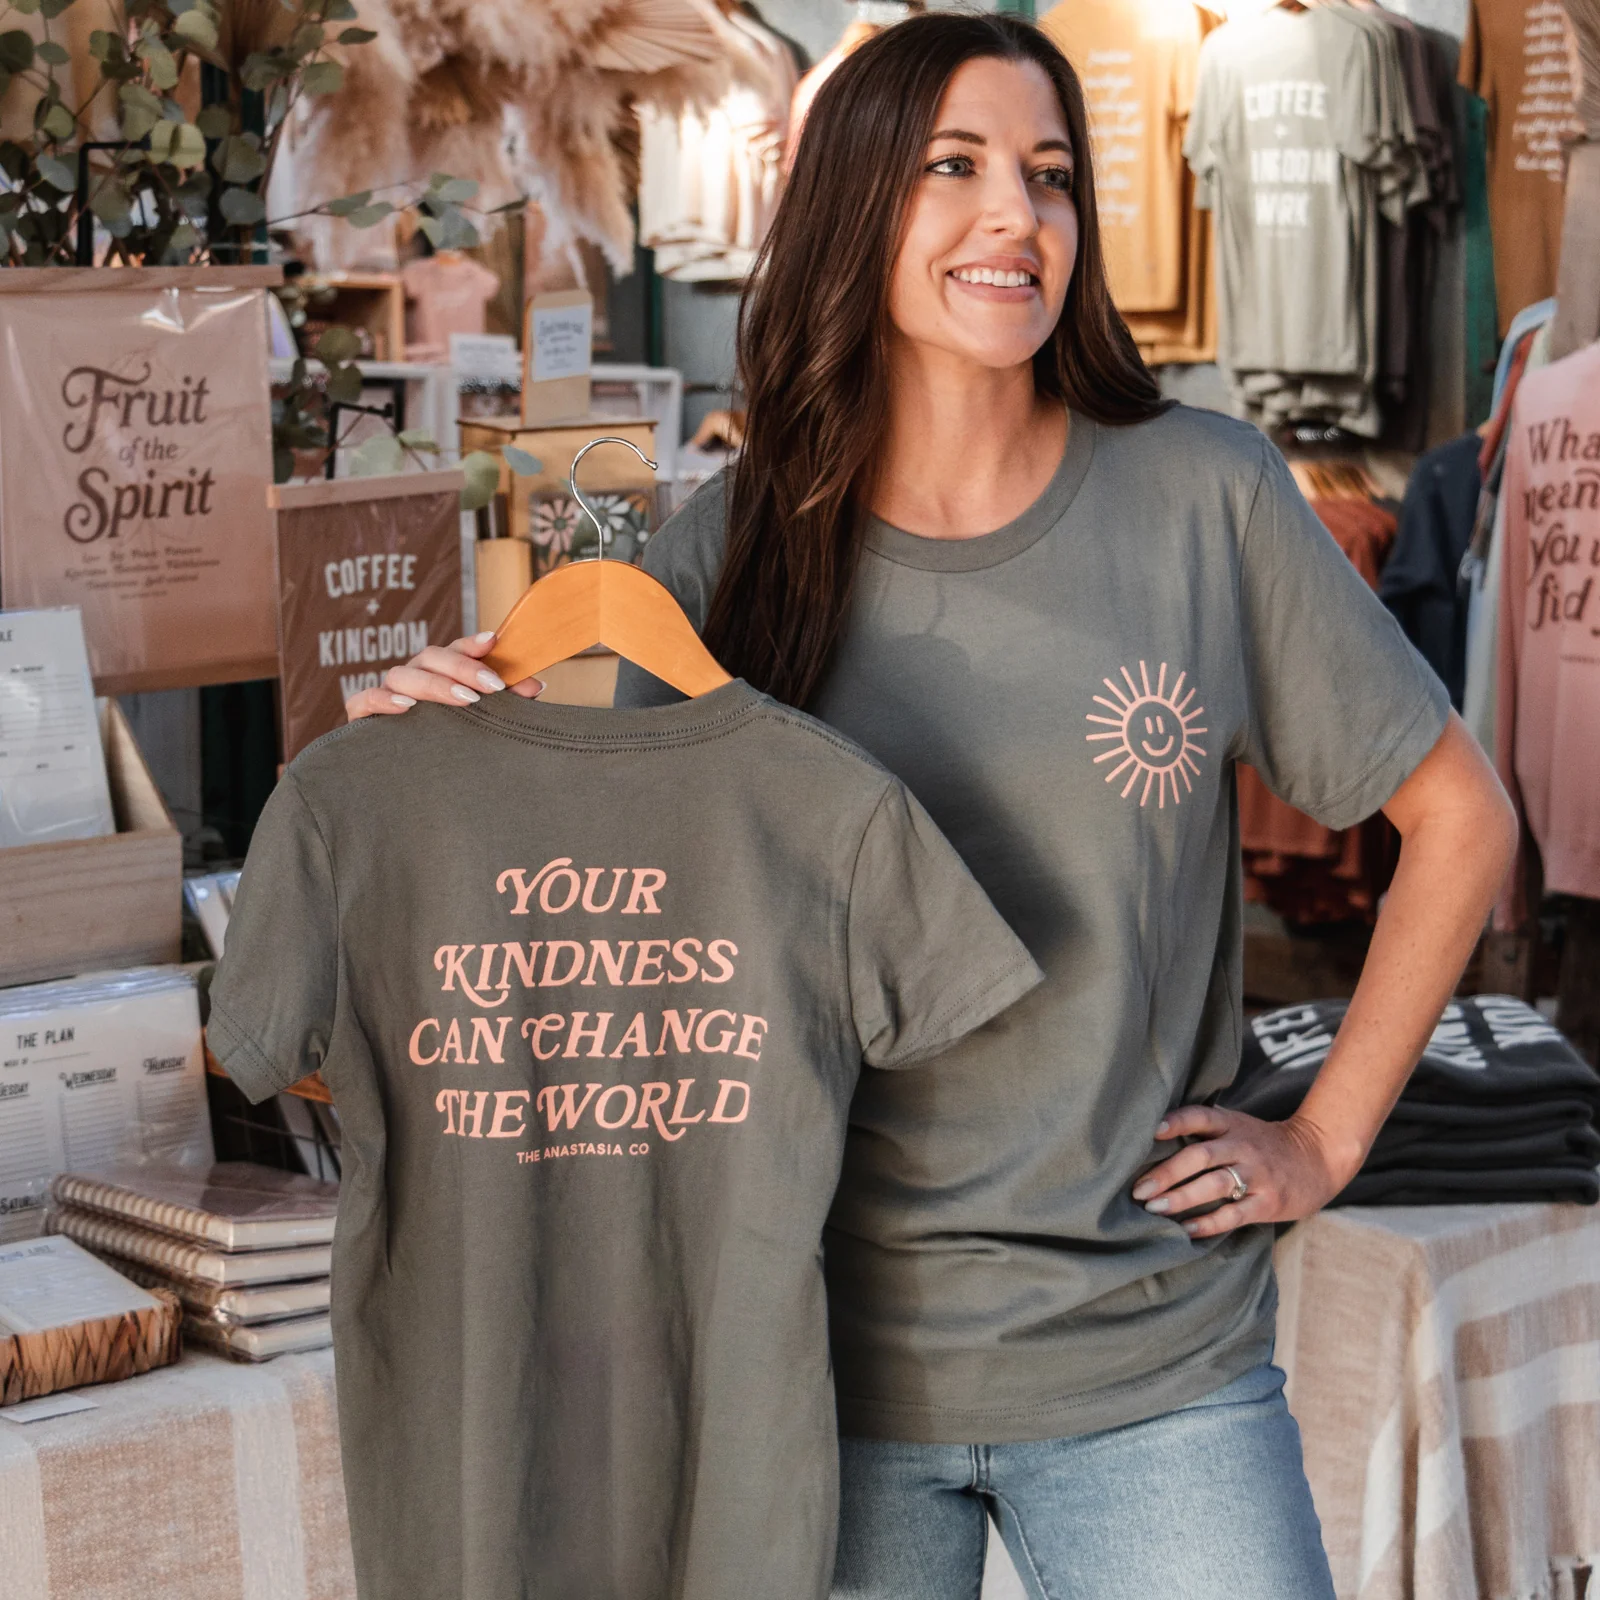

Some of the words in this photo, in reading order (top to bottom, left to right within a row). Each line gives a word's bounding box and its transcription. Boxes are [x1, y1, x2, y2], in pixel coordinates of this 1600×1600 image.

[62, 361, 210, 454] Fruit
[119, 437, 142, 468] of
[143, 437, 178, 461] the
[64, 467, 216, 544] Spirit
[324, 553, 417, 598] COFFEE
[318, 620, 428, 668] KINGDOM
[496, 857, 667, 915] YOUR
[434, 938, 738, 1008] KINDNESS
[17, 1032, 38, 1049] THE
[44, 1027, 75, 1044] PLAN
[408, 1016, 513, 1065] CAN
[521, 1008, 768, 1062] CHANGE
[435, 1088, 530, 1138] THE
[536, 1078, 751, 1142] WORLD
[516, 1150, 541, 1164] THE
[543, 1142, 623, 1161] ANASTASIA
[629, 1142, 650, 1156] CO
